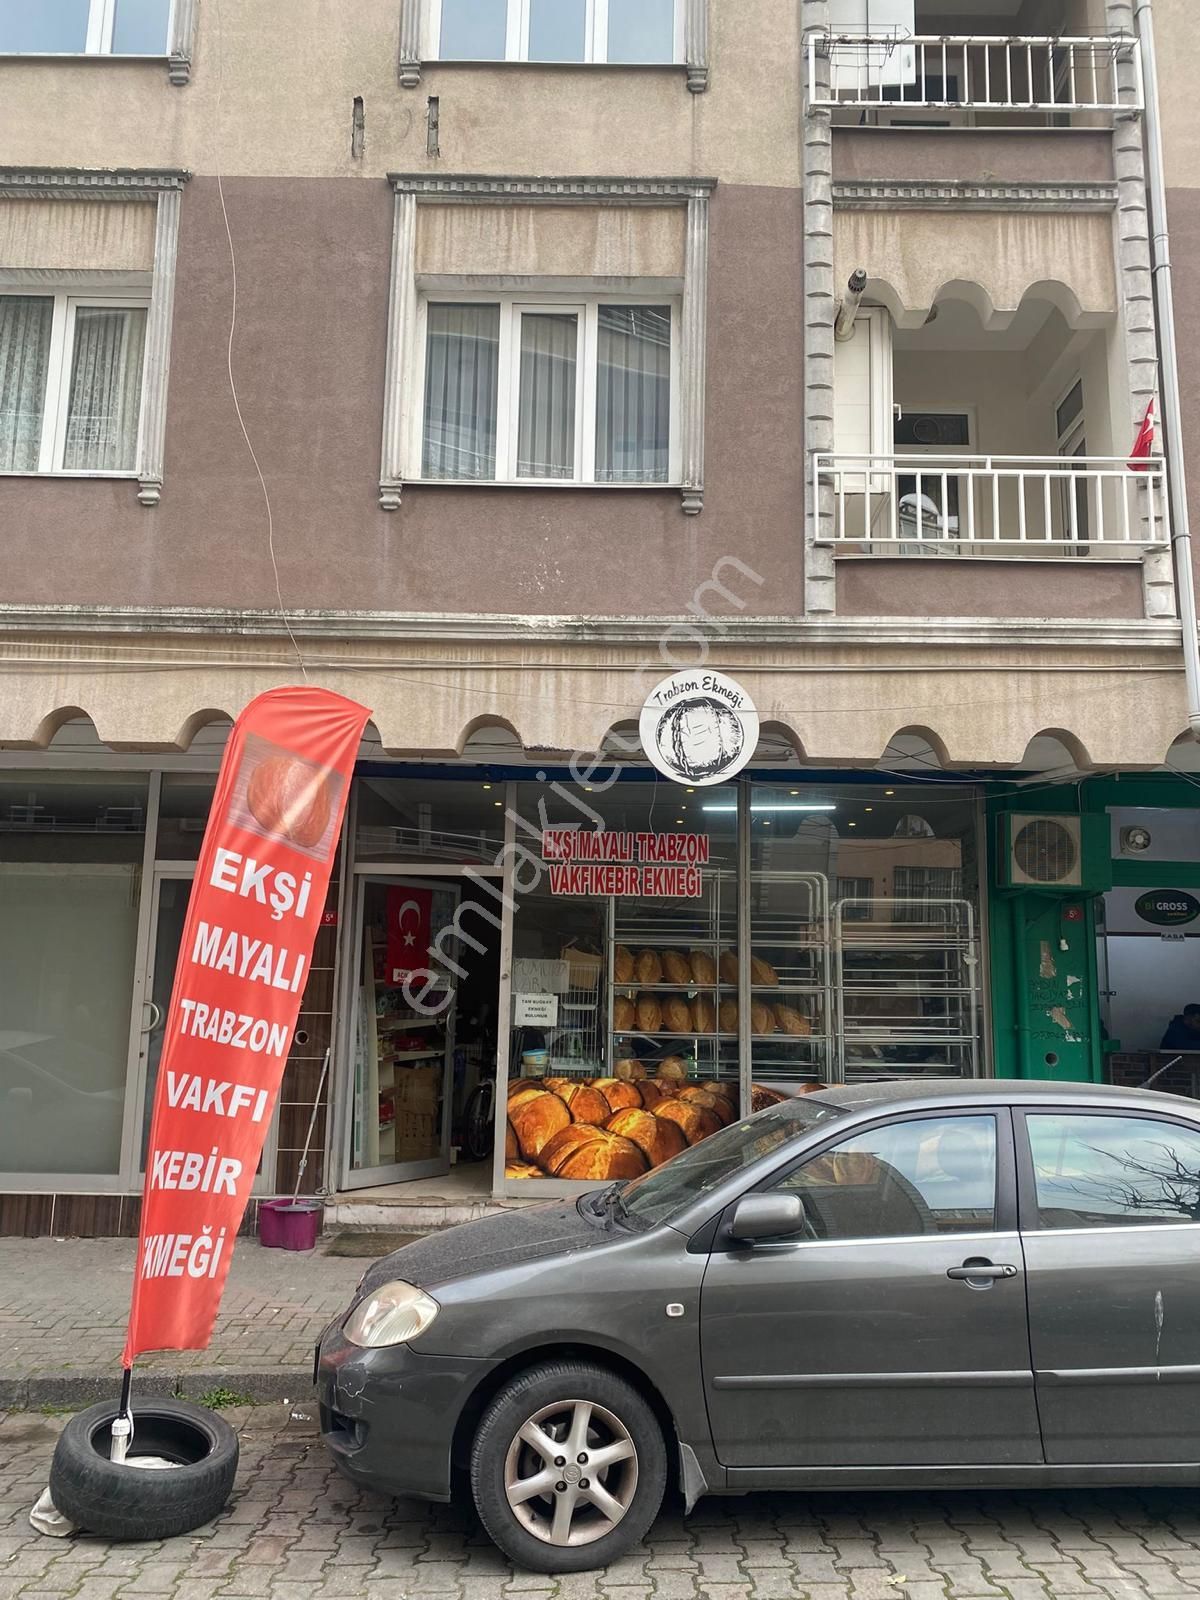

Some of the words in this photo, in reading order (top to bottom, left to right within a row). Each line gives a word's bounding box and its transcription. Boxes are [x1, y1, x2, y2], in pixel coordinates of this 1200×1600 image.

[653, 680, 699, 705] Trabzon
[702, 676, 744, 708] Ekmeği
[578, 831, 634, 861] MAYALI
[636, 833, 709, 864] TRABZON
[209, 847, 313, 921] EKŞİ
[191, 921, 306, 993] MAYALI
[181, 998, 289, 1057] TRABZON
[167, 1071, 269, 1122] VAKFI
[151, 1146, 243, 1196] KEBİR
[142, 1225, 226, 1279] KMEĞİ
